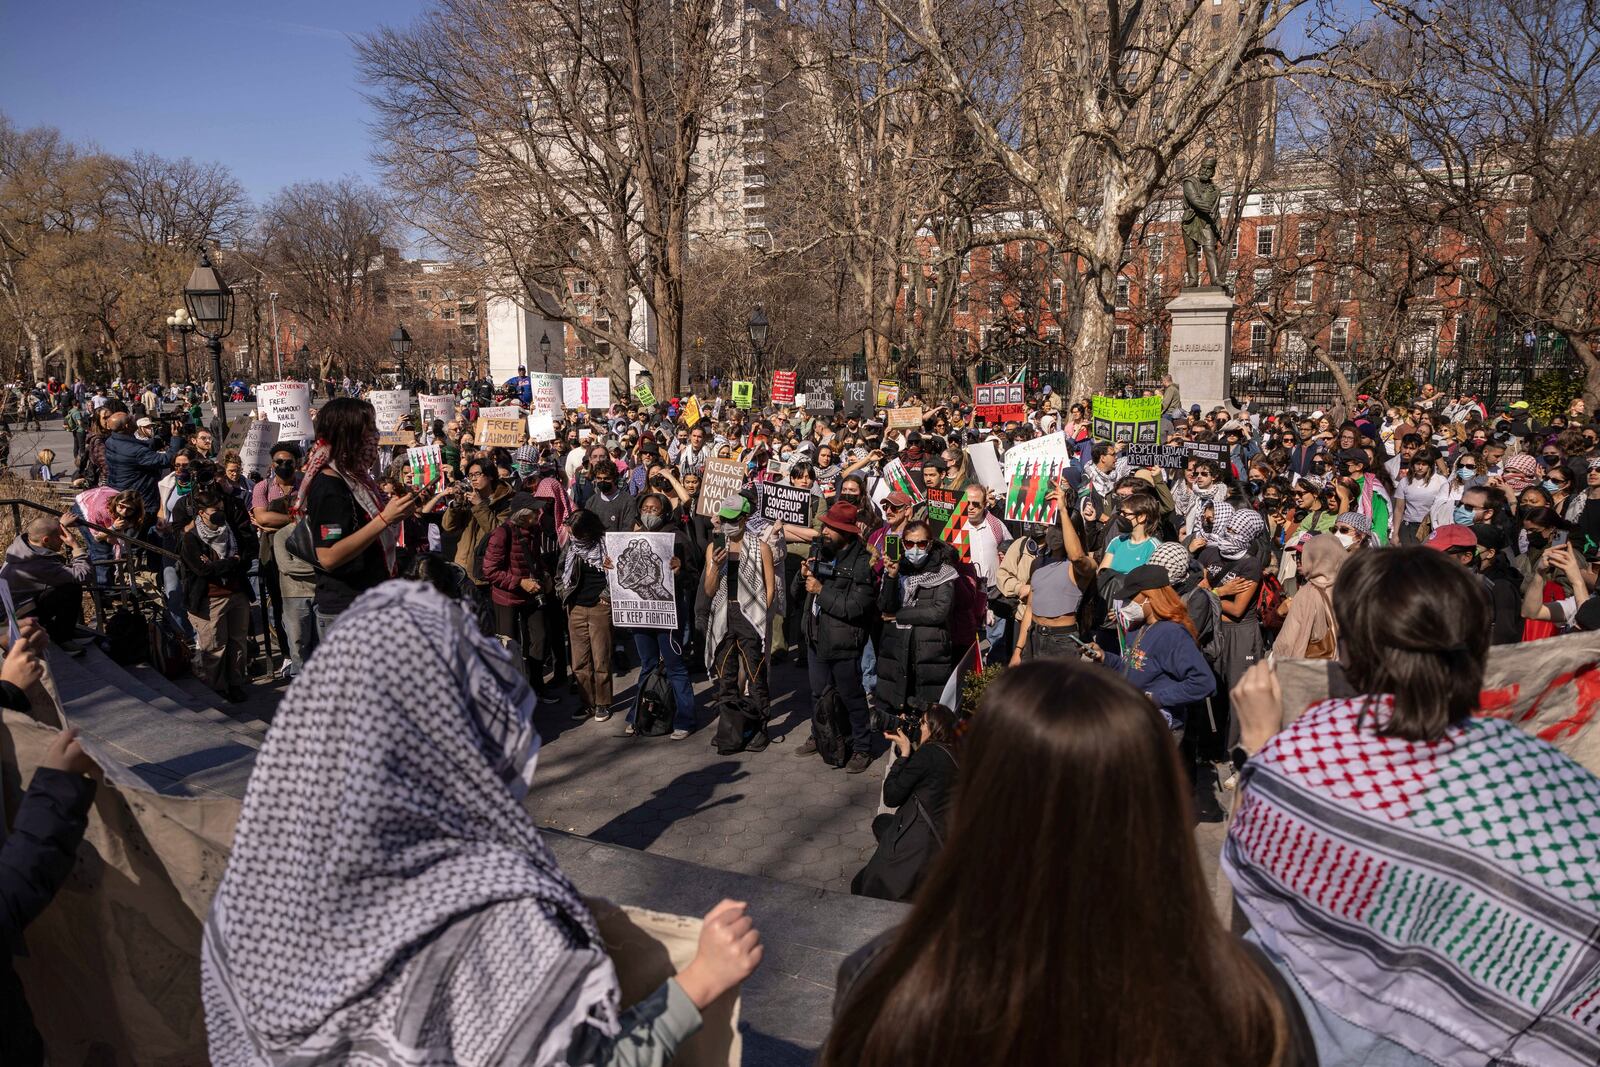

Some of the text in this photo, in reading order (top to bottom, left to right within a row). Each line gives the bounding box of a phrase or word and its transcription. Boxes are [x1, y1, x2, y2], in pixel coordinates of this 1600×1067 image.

[805, 378, 834, 387] NEW YORK
[845, 381, 867, 392] MELT
[813, 386, 826, 394] WAS
[850, 391, 865, 401] ICE
[269, 398, 286, 406] FREE
[1092, 396, 1118, 408] FREE
[1093, 406, 1161, 420] FREE PALESTINE
[282, 421, 300, 430] NOW!
[487, 420, 519, 431] FREE
[1128, 442, 1158, 454] RESPECT
[1127, 454, 1135, 464] OR
[1136, 454, 1153, 465] EXPECT
[1193, 451, 1218, 459] GENOCIDE
[708, 461, 744, 477] RELEASE
[705, 473, 743, 490] MAHMOUD
[763, 484, 810, 503] YOU CANNOT
[928, 488, 956, 503] FREE ALL
[702, 498, 722, 515] NO
[767, 496, 801, 512] COVERUP
[764, 508, 804, 523] GENOCIDE
[613, 600, 675, 611] NO MATTER WHO IS ELECTED
[614, 611, 677, 625] WE KEEP FIGHTING
